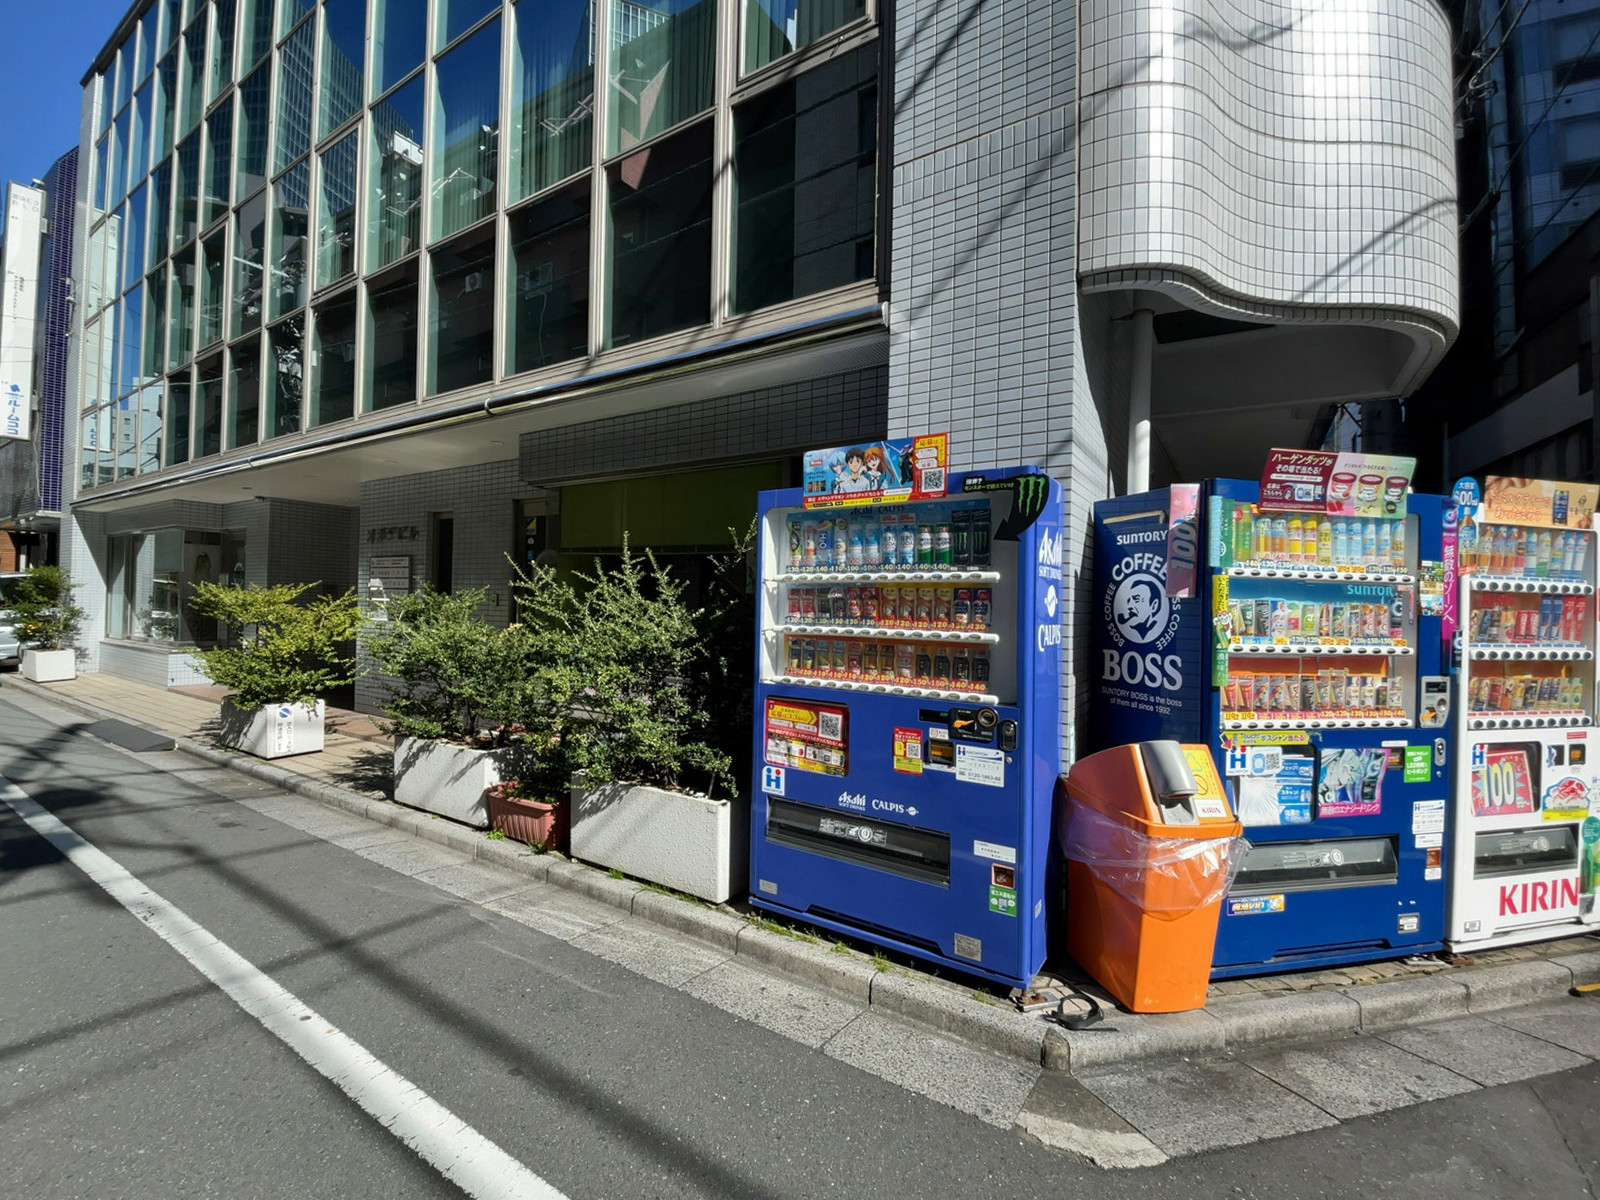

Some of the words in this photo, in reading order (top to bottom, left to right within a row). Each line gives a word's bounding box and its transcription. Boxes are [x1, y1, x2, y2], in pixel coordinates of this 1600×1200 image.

[1272, 453, 1333, 466] ハーゲンダッツが
[1275, 464, 1322, 475] その場で当たる!
[1039, 527, 1063, 567] Asahi
[1117, 530, 1168, 546] SUNTORY
[1104, 582, 1117, 621] COFFEE
[1347, 584, 1399, 598] SUNTOR
[1038, 624, 1061, 652] CALPIS
[1107, 623, 1125, 648] BOSS
[1155, 614, 1180, 651] COFFEE
[1102, 649, 1183, 691] BOSS
[1102, 686, 1129, 699] SUNTORY
[1130, 689, 1148, 701] BOSS
[1155, 693, 1165, 704] the
[1166, 695, 1183, 707] boss
[1117, 698, 1129, 707] them
[1138, 701, 1153, 712] since
[1155, 703, 1171, 715] 1992
[1480, 762, 1515, 809] 100
[838, 791, 866, 807] Asahi
[872, 799, 905, 814] CALPIS
[1499, 877, 1580, 917] KIRIN
